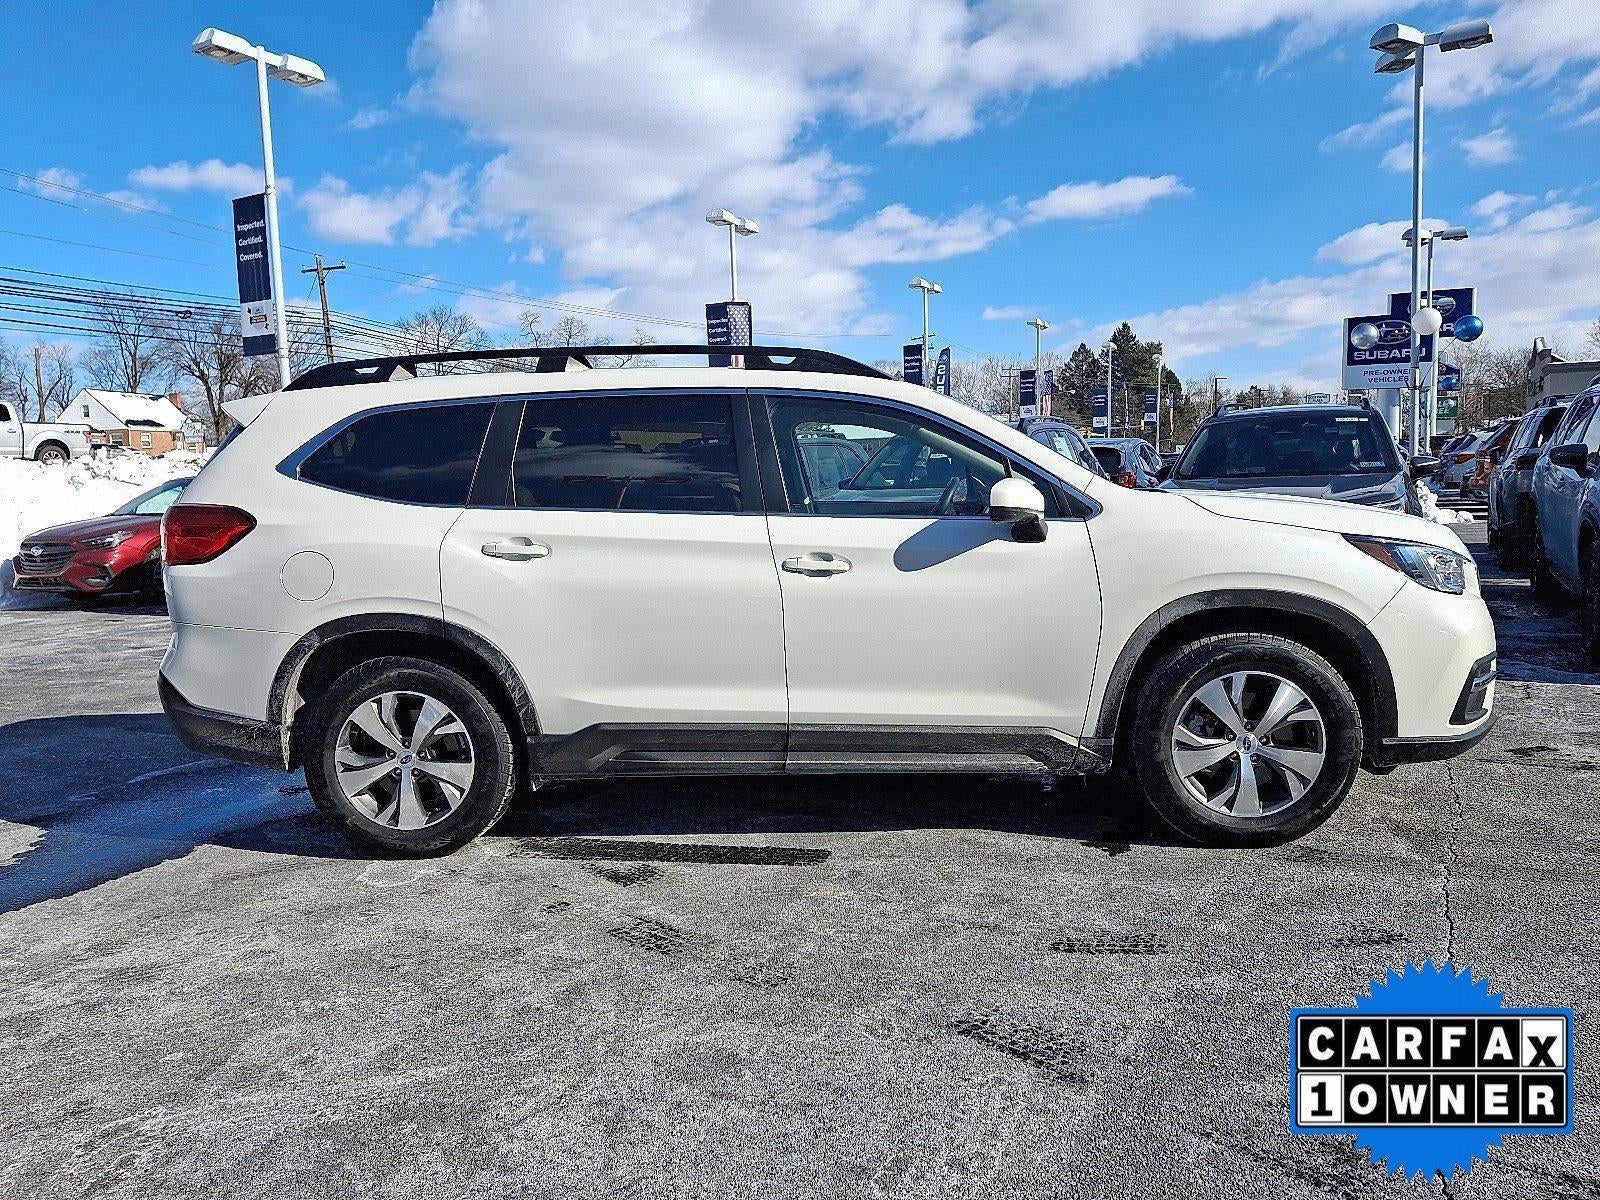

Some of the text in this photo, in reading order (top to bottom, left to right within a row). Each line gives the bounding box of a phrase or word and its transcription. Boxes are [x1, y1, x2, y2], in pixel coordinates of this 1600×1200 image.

[237, 219, 265, 231] Inspected.
[238, 235, 263, 246] Certified.
[240, 251, 263, 261] Covered.
[1353, 347, 1426, 360] SUBARU
[1367, 376, 1410, 384] VEHICLES
